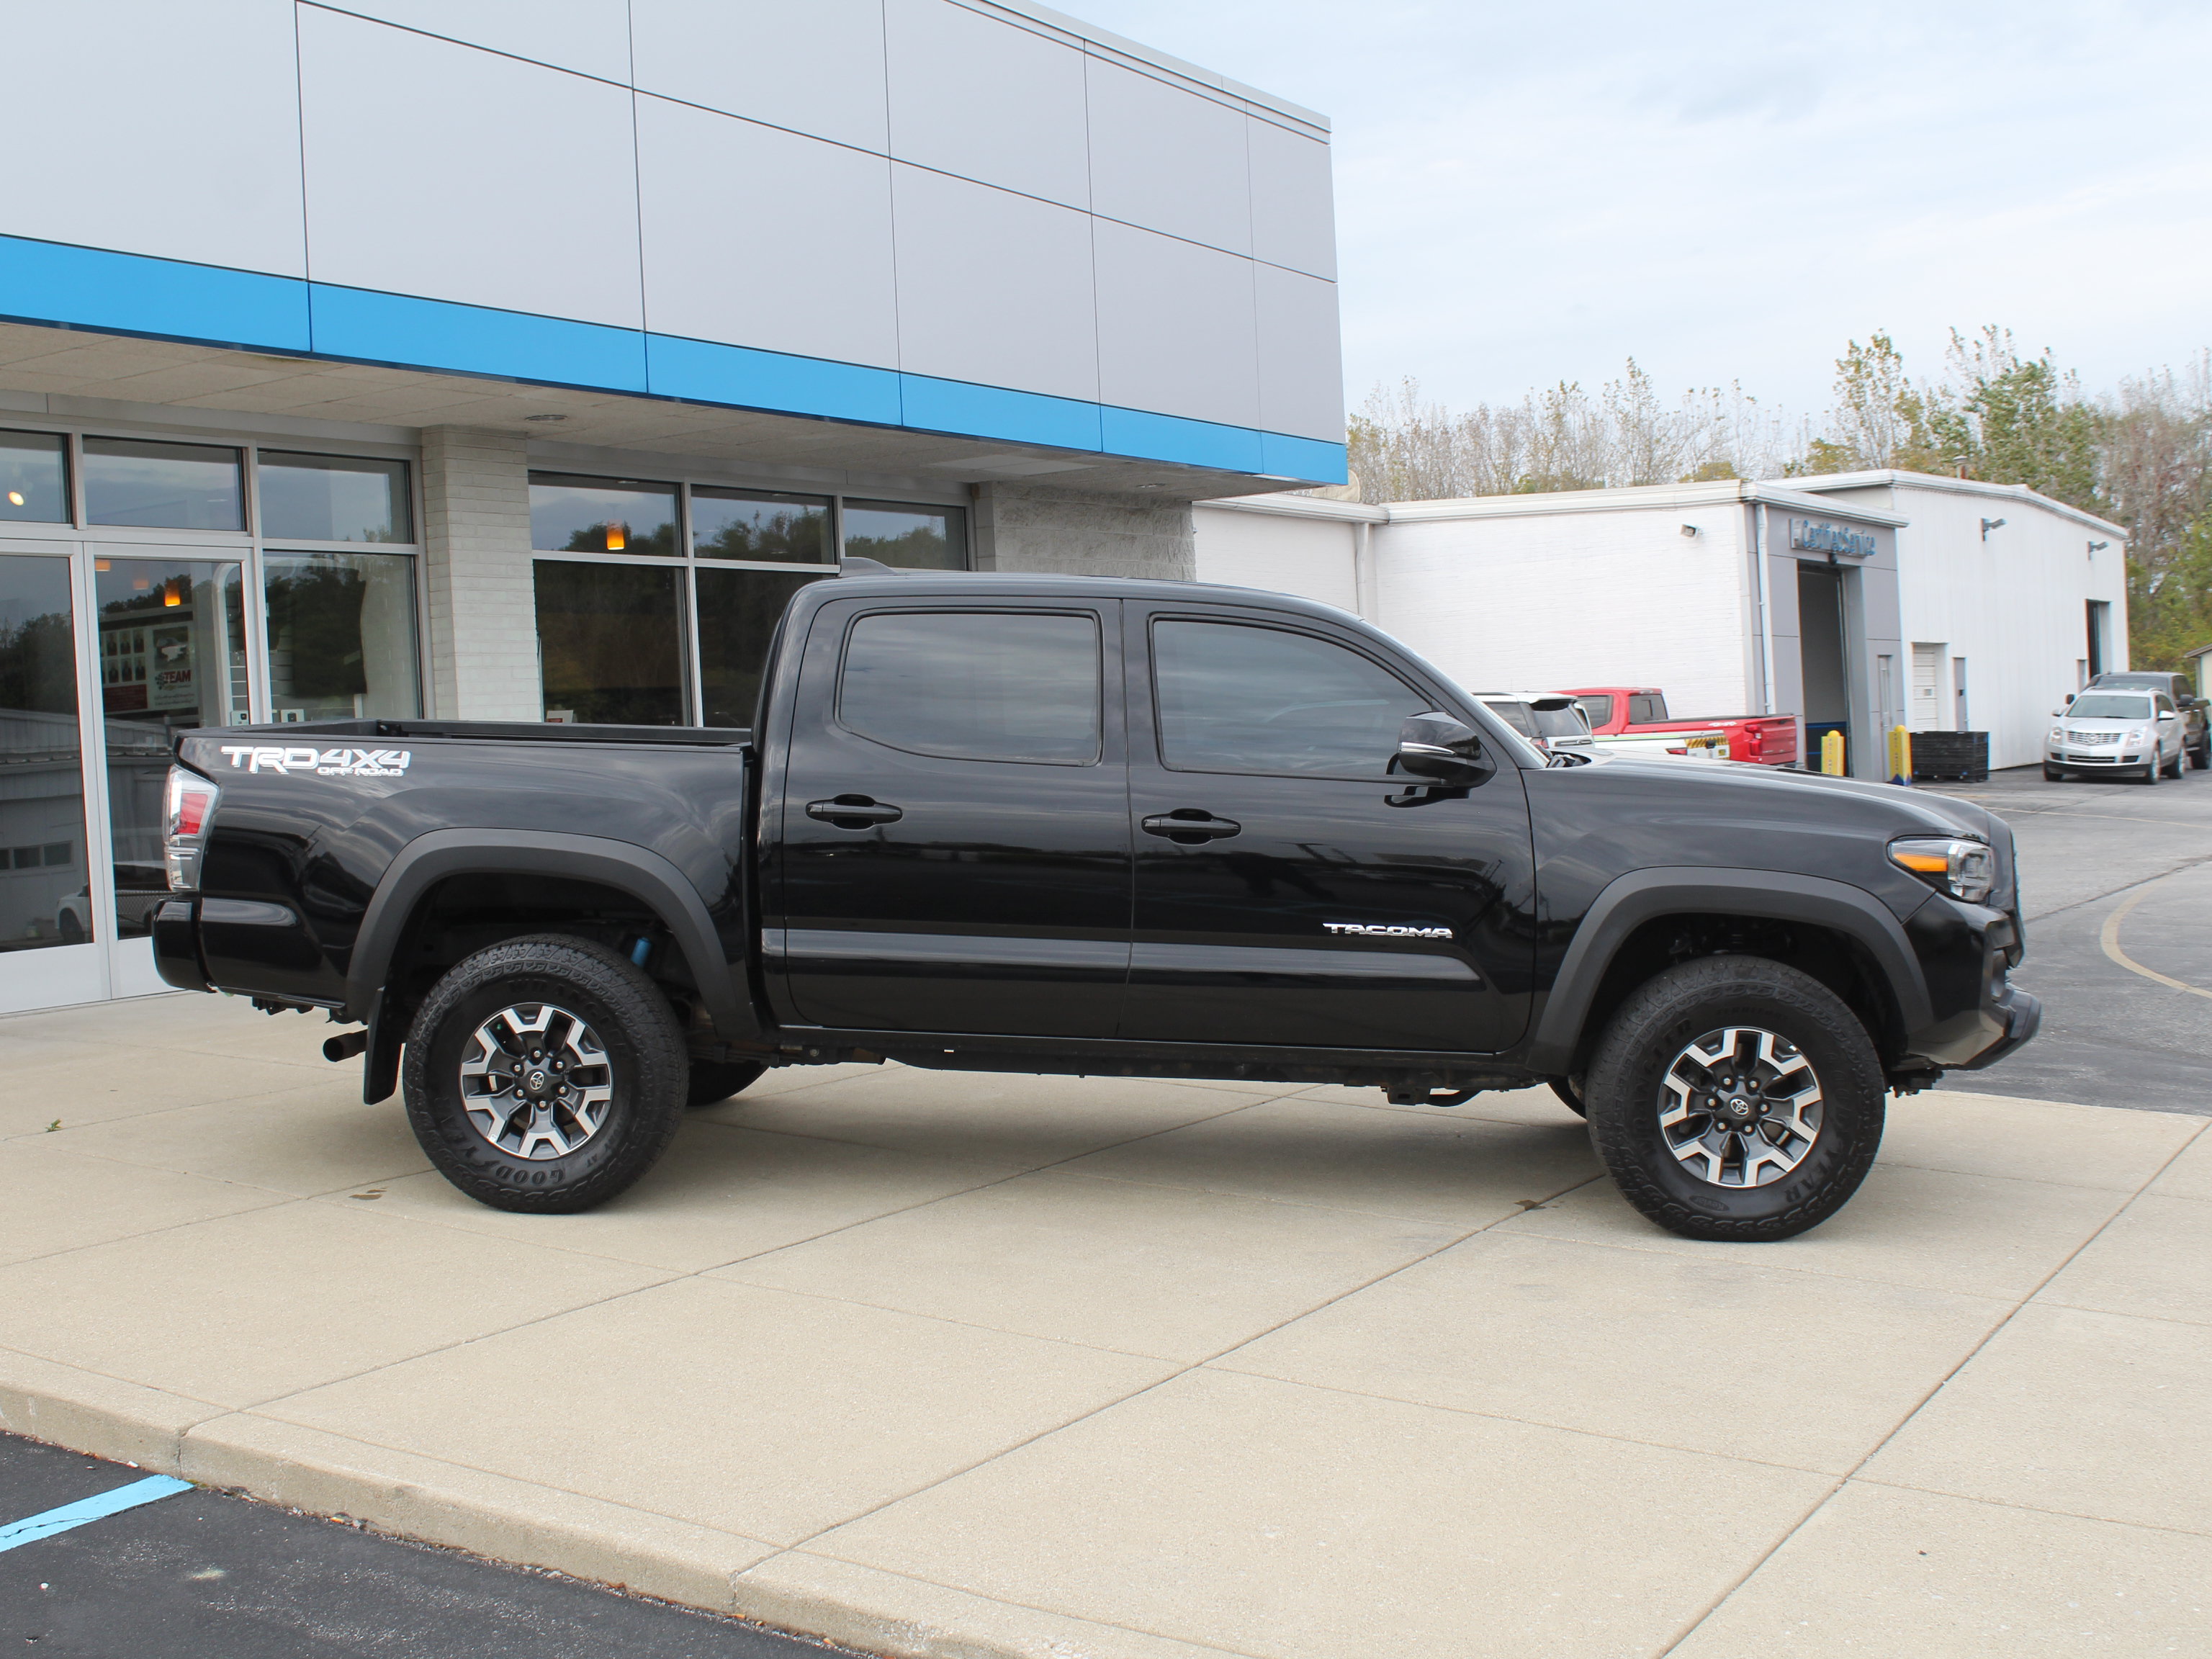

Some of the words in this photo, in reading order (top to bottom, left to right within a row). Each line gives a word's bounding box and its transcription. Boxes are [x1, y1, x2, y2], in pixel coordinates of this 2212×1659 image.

[163, 669, 192, 685] TEAM
[220, 746, 320, 775] TRD
[317, 767, 354, 777] OFF
[354, 768, 405, 778] ROAD
[1322, 922, 1455, 939] TACOMA
